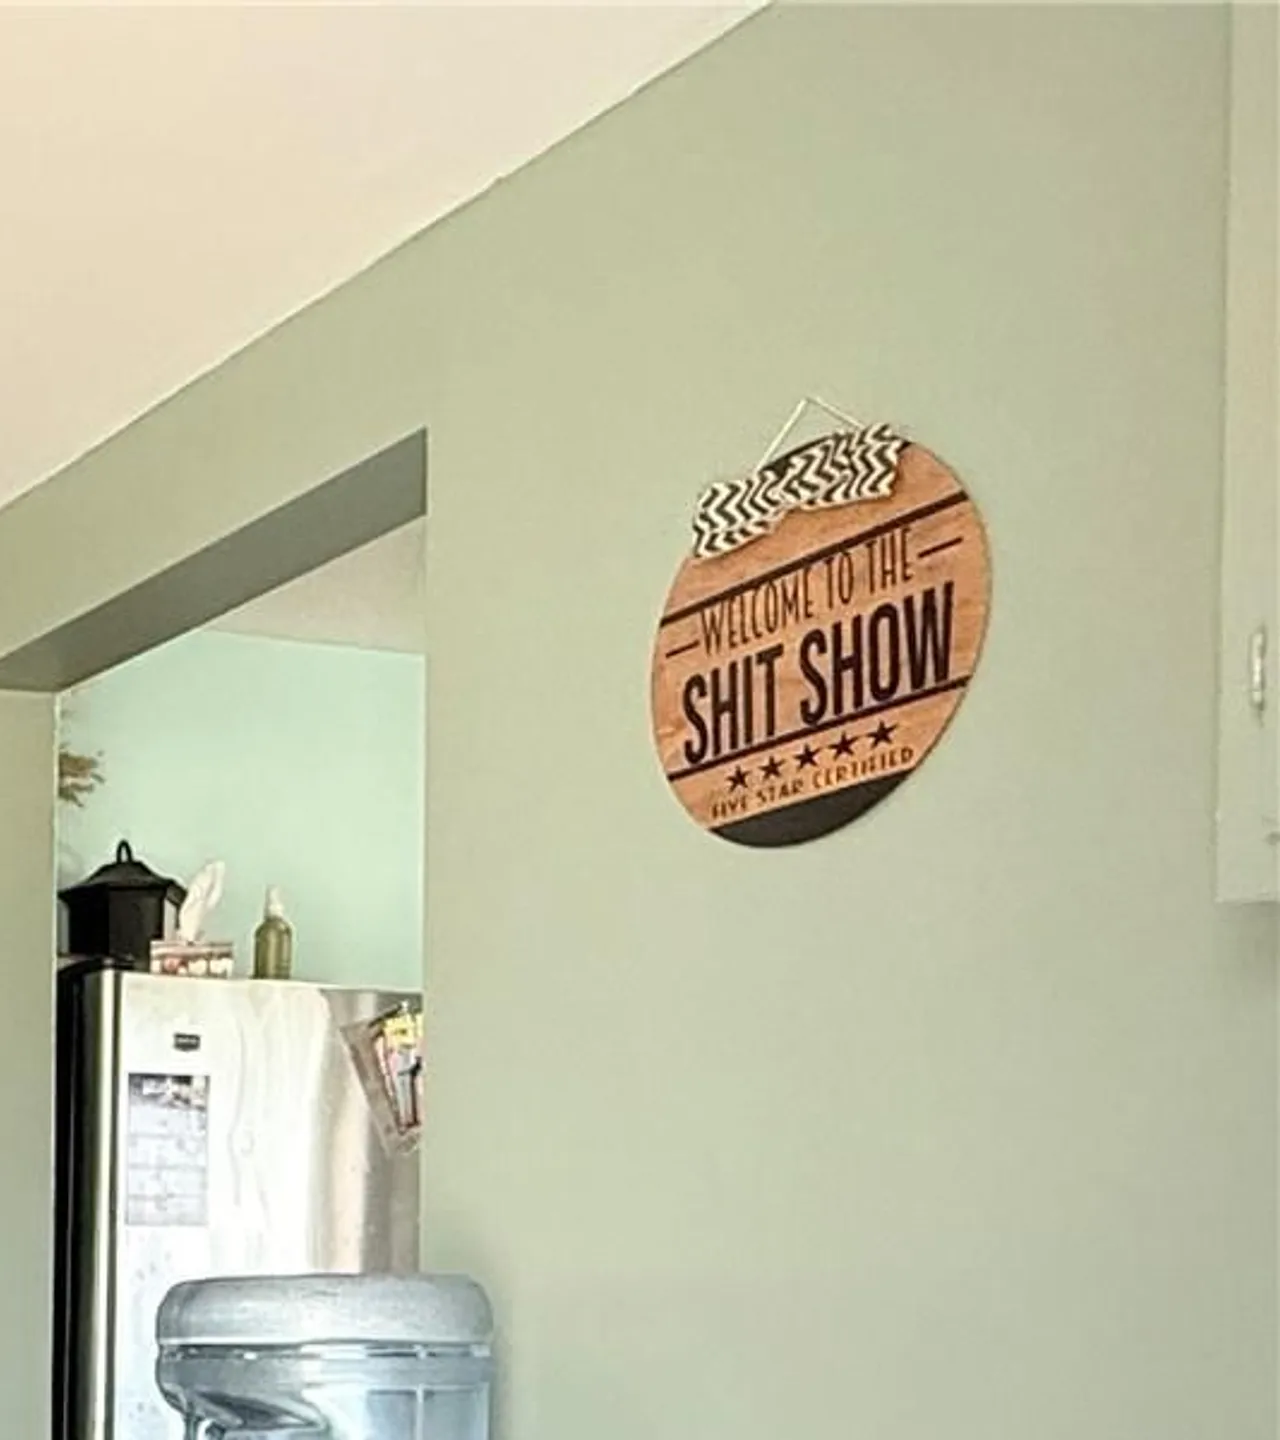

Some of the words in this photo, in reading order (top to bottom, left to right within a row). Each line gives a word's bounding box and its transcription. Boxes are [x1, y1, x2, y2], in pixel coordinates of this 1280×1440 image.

[700, 567, 815, 655] WELCOME
[824, 551, 855, 610] TO
[866, 527, 913, 594] THE
[682, 643, 785, 764] SHIT
[799, 580, 955, 727] SHOW
[756, 777, 804, 804] STAR
